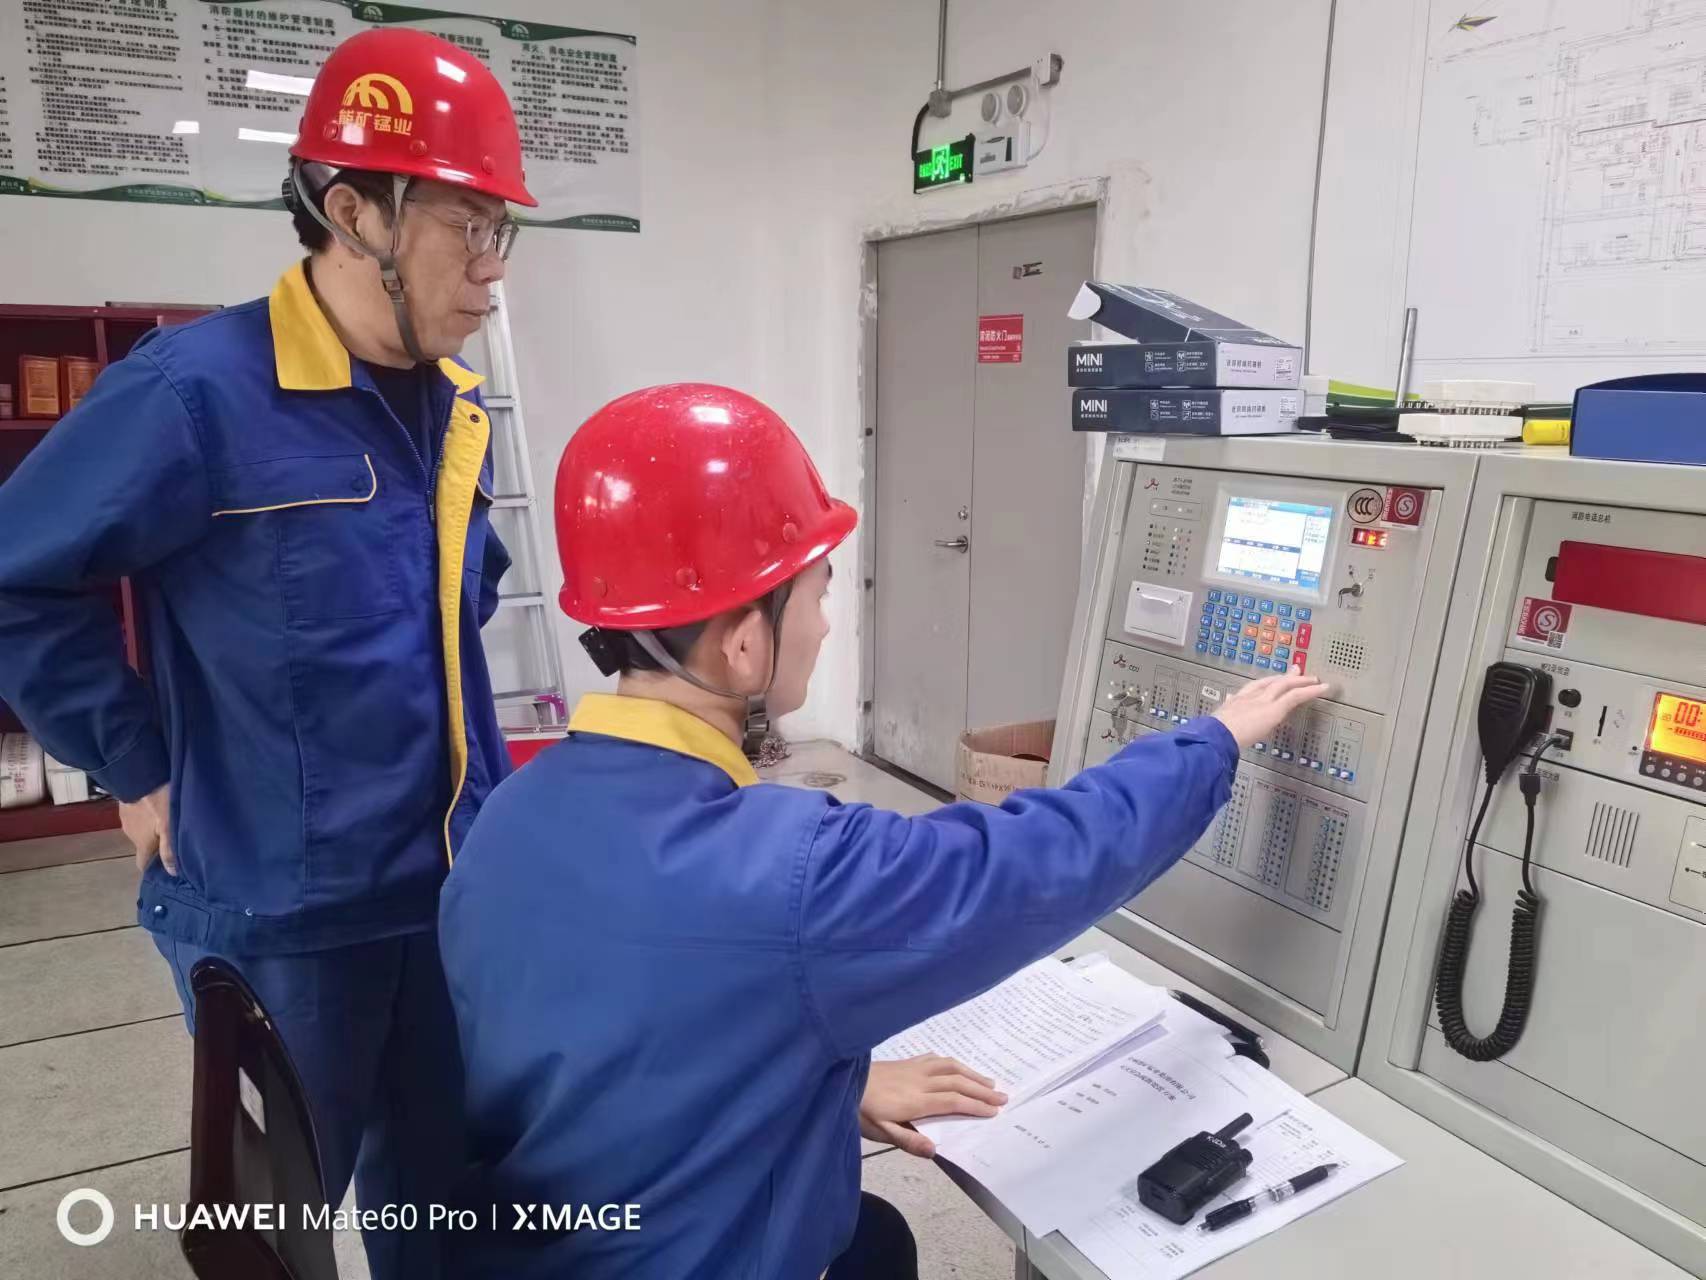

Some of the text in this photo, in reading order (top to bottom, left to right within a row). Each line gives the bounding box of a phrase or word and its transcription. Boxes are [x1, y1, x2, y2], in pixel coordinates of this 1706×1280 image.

[1076, 353, 1103, 366] MINI
[1081, 400, 1107, 412] MINI
[1571, 511, 1611, 524] 消防电话总机
